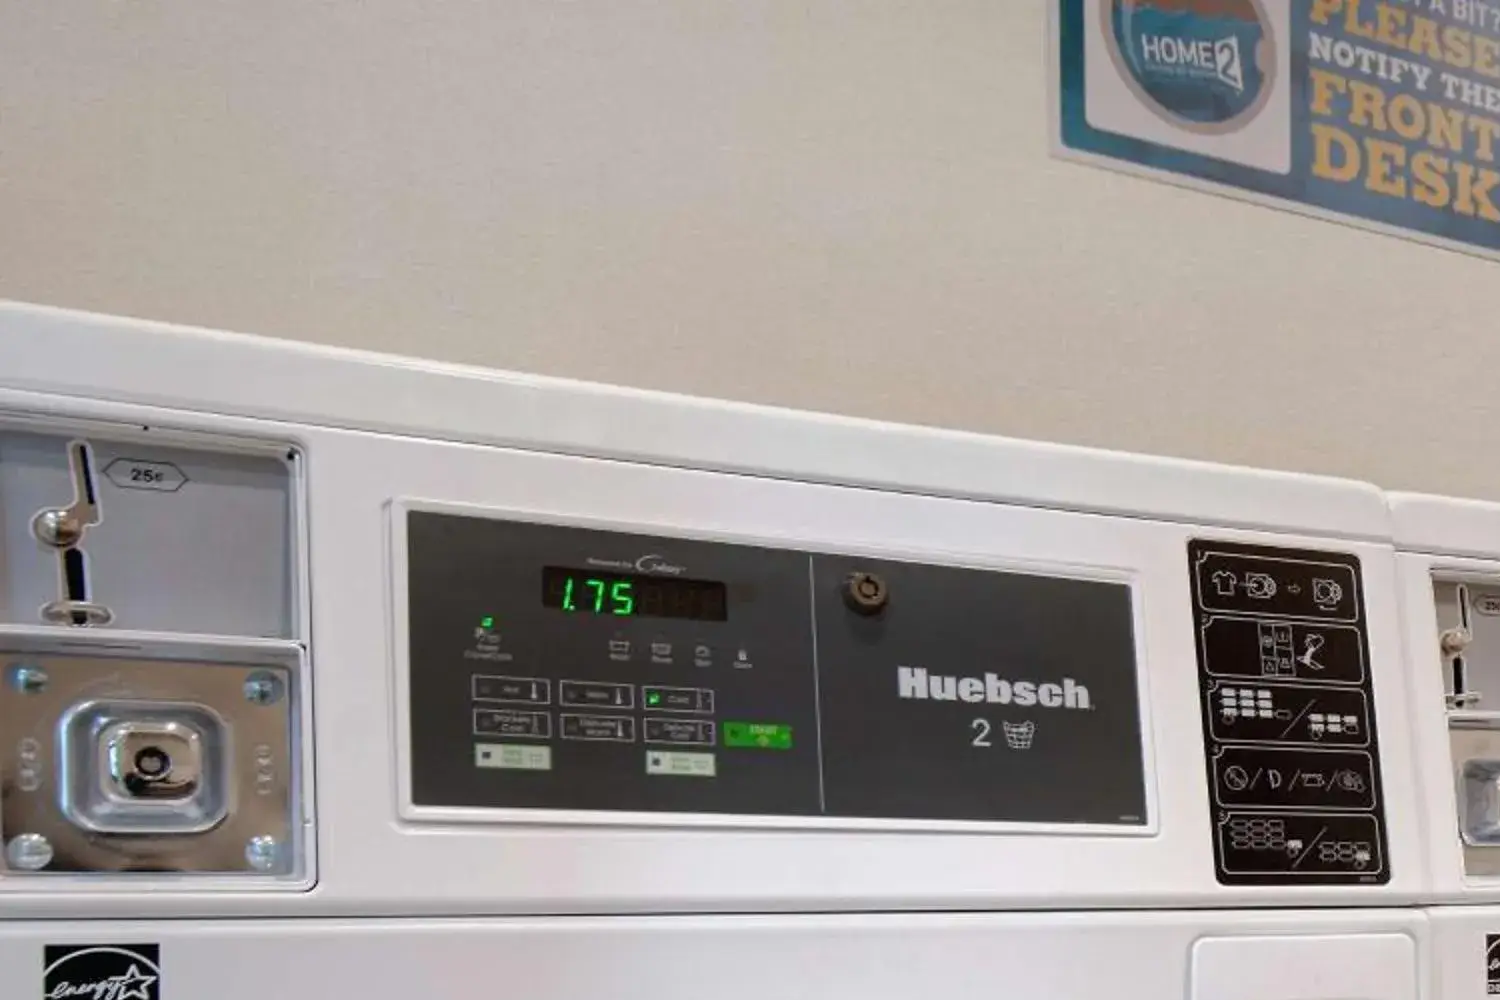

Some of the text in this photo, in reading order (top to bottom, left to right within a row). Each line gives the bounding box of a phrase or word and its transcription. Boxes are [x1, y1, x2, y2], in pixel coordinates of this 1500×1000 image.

[1308, 31, 1432, 91] NOTIFY
[562, 577, 634, 615] 1.75
[898, 666, 1092, 710] Huebsch
[971, 718, 992, 747] 2
